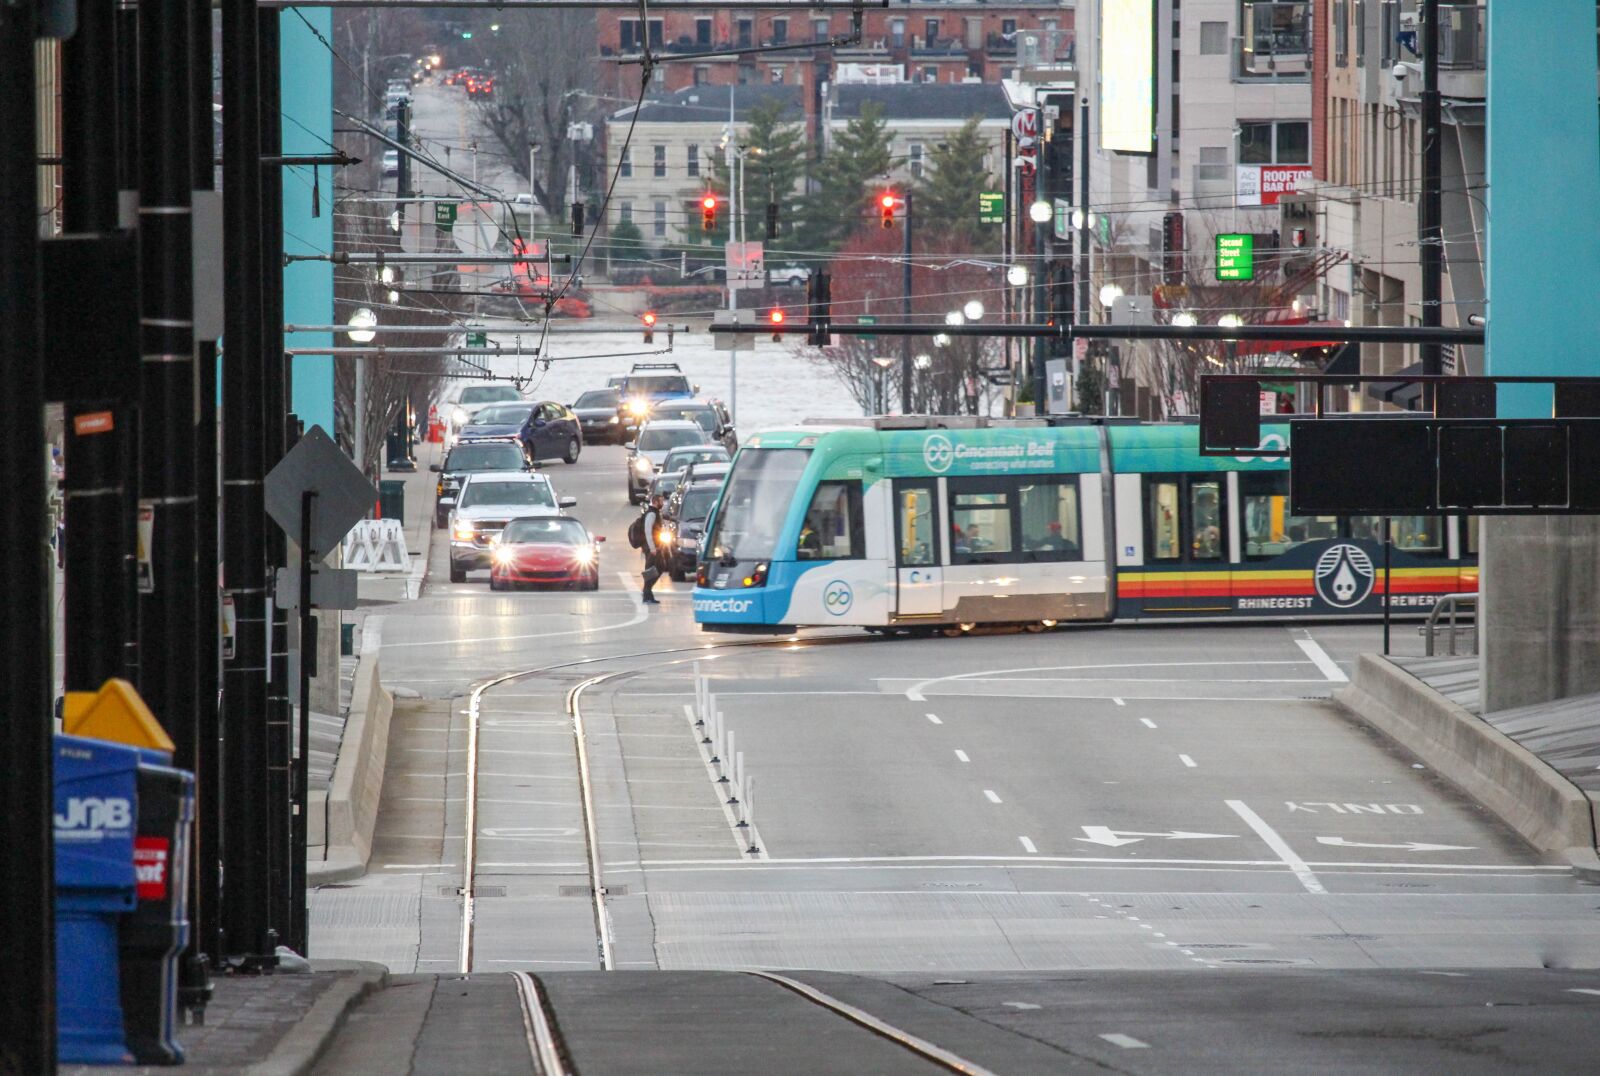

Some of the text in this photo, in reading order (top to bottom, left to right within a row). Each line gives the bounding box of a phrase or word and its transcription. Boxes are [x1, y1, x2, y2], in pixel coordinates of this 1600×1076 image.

[1263, 182, 1284, 192] BAR
[437, 205, 450, 214] Way
[1220, 238, 1243, 247] Second
[1220, 248, 1240, 257] Street
[1220, 258, 1234, 267] East
[955, 442, 1056, 458] Cincinnati Bell
[1238, 597, 1314, 609] RHINEGEIST
[1285, 801, 1424, 815] ONLY
[54, 798, 131, 830] JOB
